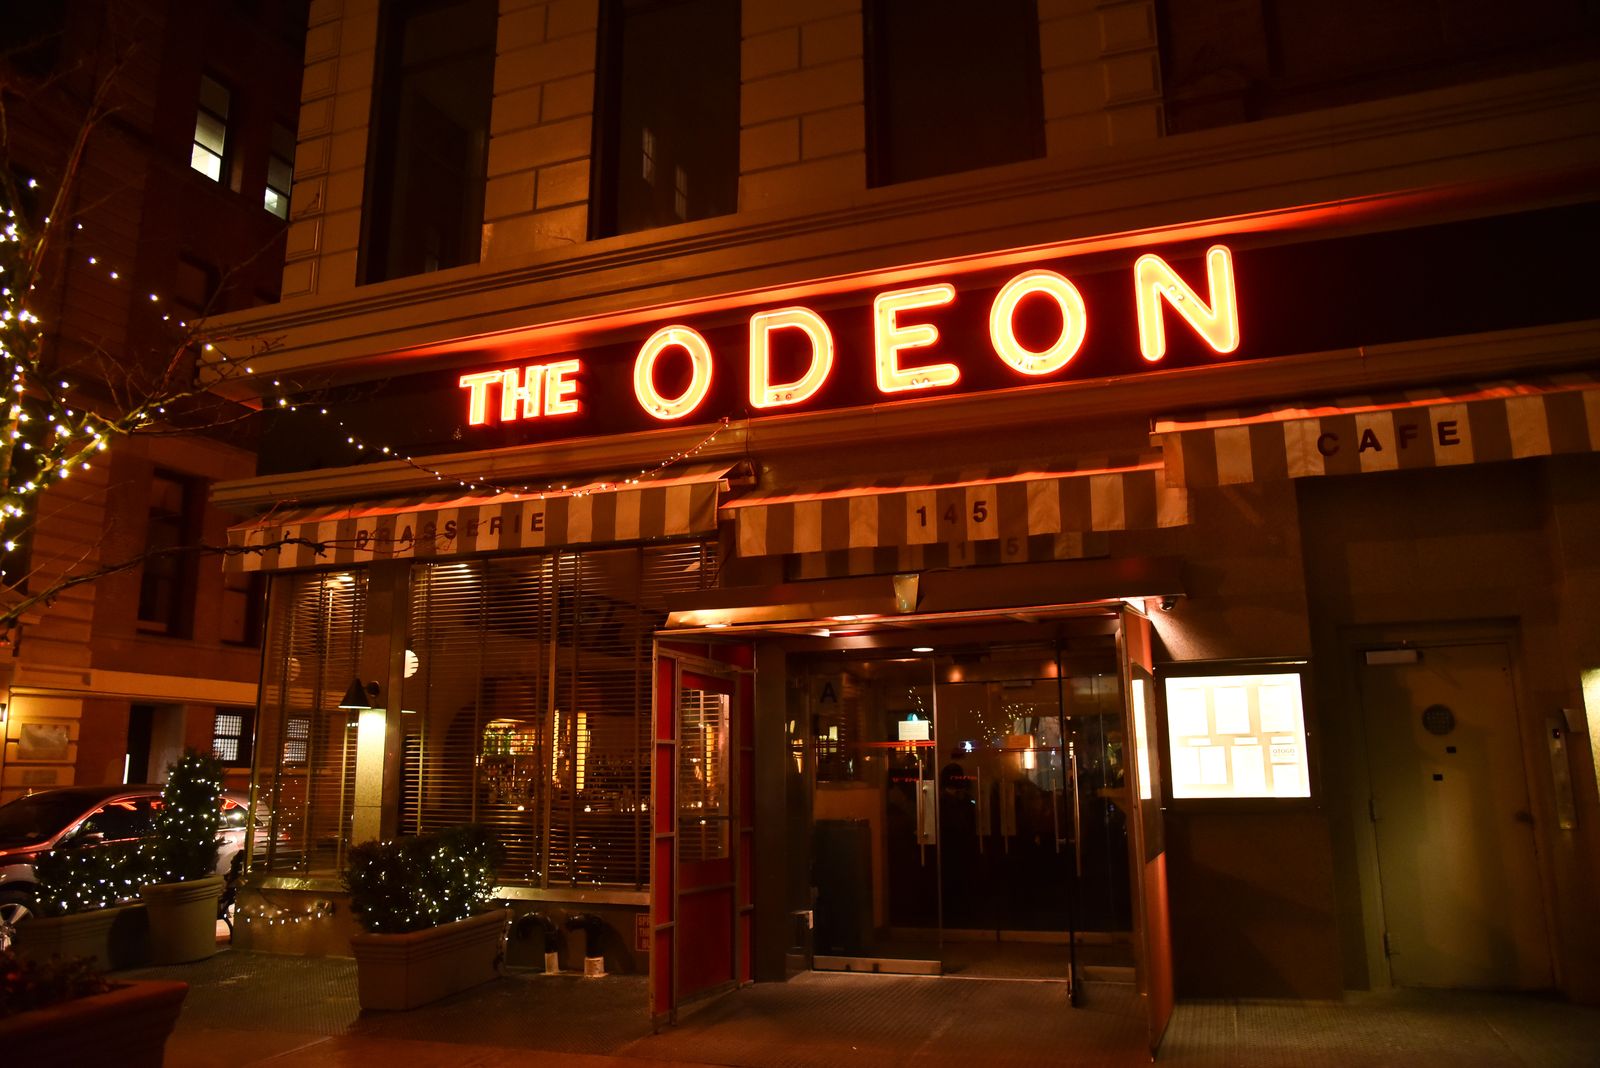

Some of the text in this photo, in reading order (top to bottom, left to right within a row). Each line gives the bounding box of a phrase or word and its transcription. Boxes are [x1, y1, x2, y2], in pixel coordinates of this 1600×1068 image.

[459, 244, 1240, 425] THE ODEON
[1317, 420, 1460, 457] CAFE
[356, 512, 544, 550] BRASSERIE
[916, 501, 987, 527] 145
[820, 681, 838, 703] A
